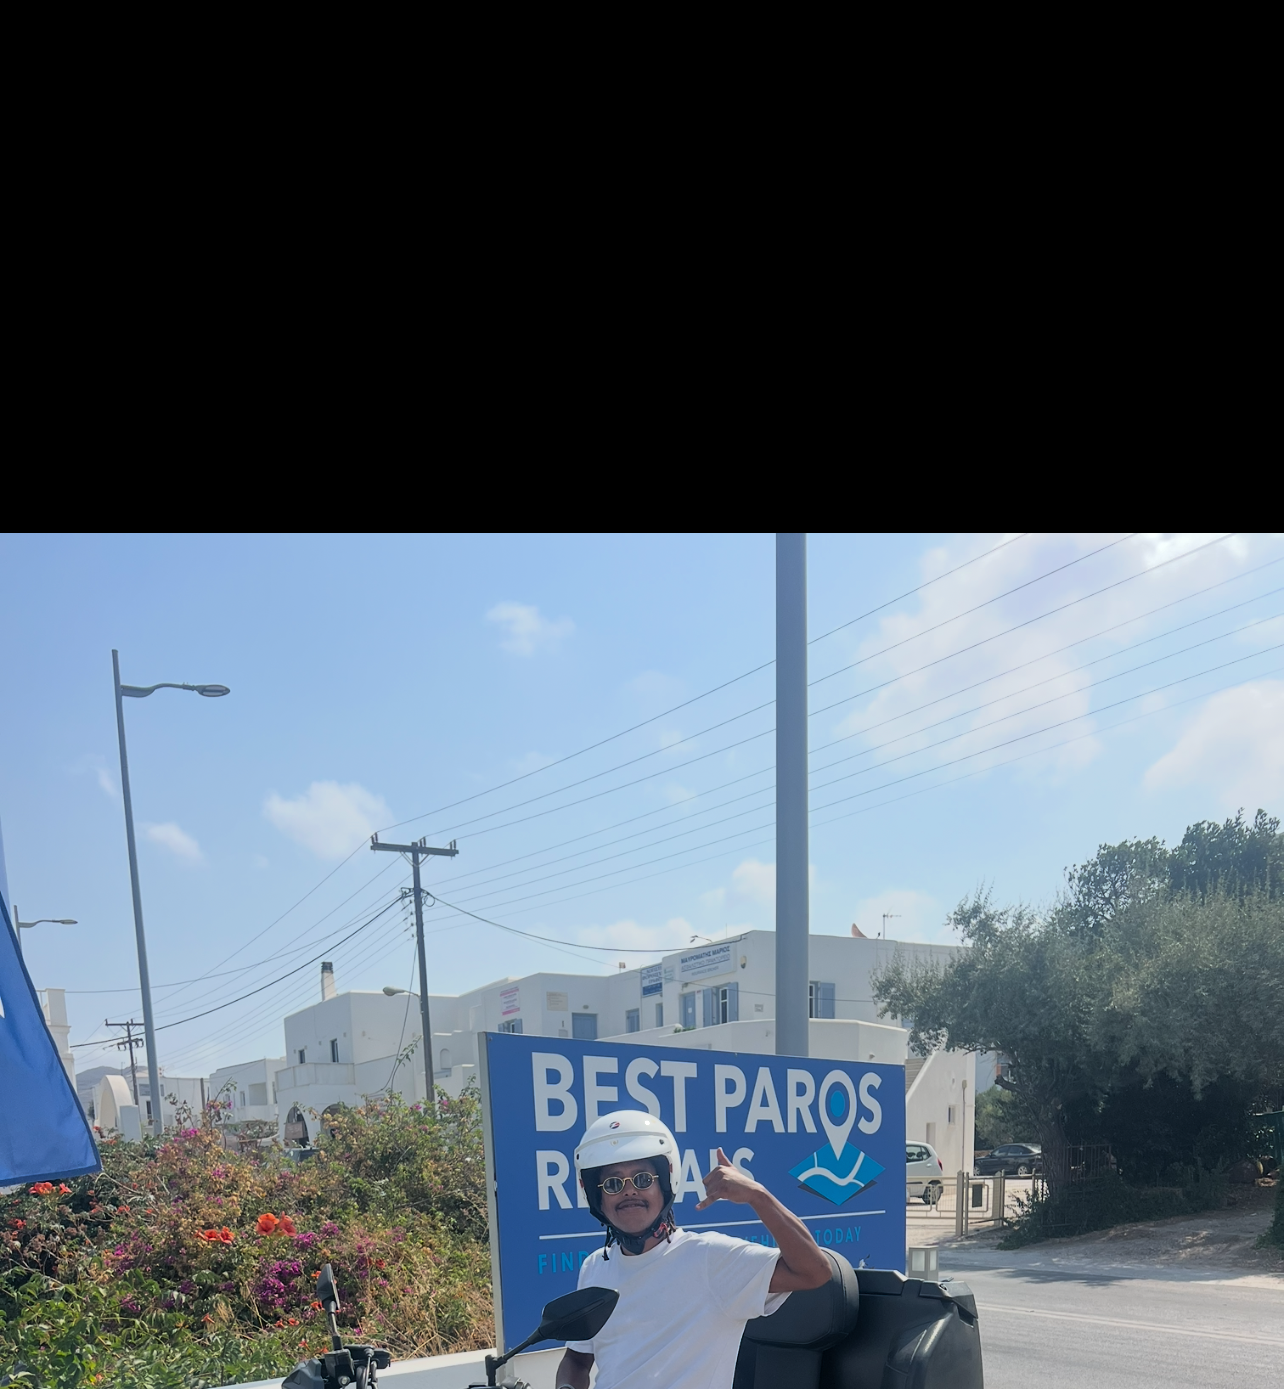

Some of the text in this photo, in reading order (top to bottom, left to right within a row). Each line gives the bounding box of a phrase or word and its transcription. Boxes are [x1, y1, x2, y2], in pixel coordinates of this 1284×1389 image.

[532, 1052, 883, 1136] BEST PAROS
[814, 1226, 861, 1247] TODAY
